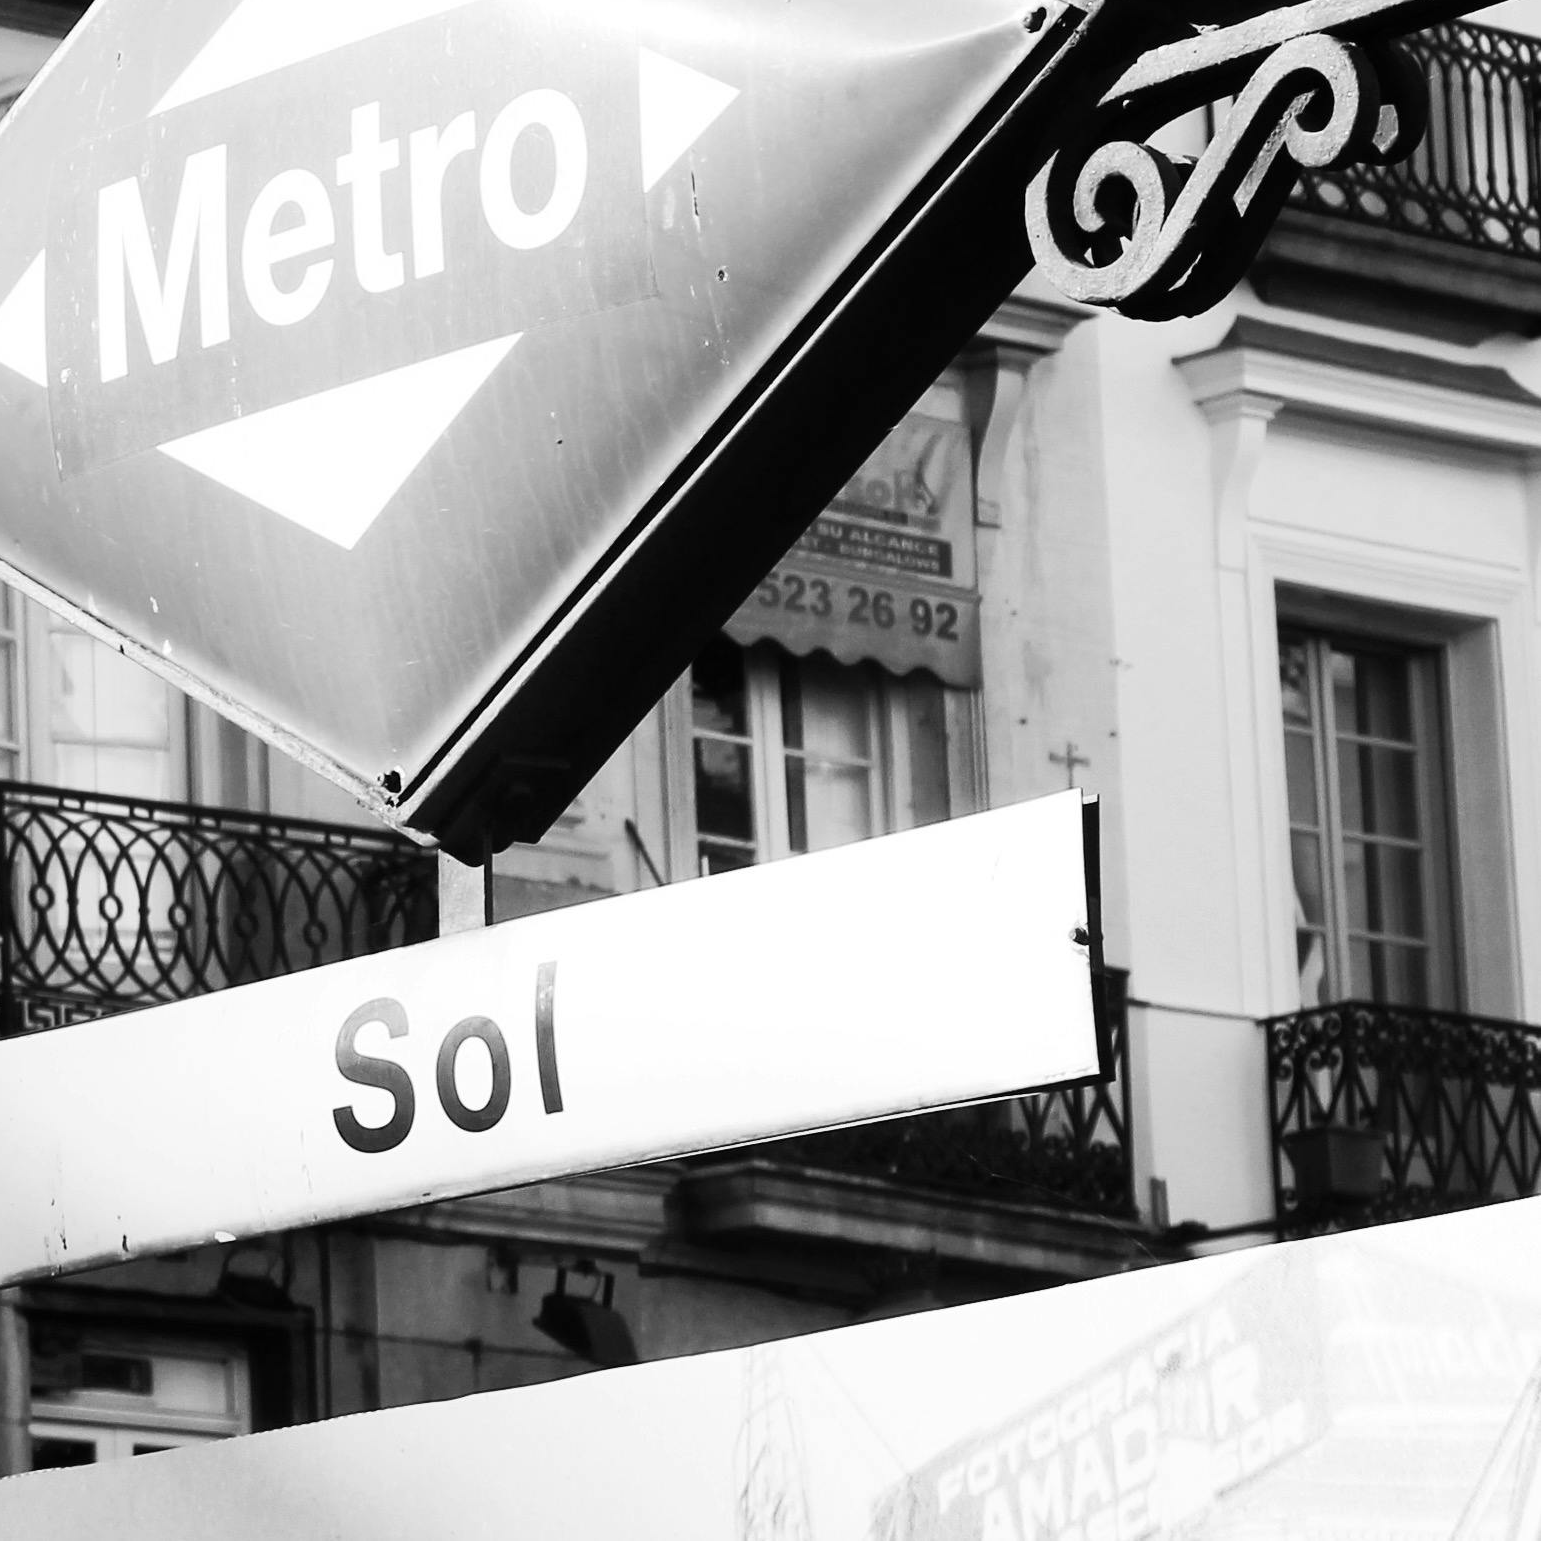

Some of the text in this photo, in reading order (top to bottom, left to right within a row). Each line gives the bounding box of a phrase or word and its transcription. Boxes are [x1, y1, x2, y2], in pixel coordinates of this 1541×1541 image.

[97, 88, 587, 384] Metro
[757, 572, 959, 642] 523 26 92
[849, 530, 939, 556] ALCANCE
[333, 961, 564, 1154] Sol
[981, 1342, 1259, 1541] AMADR
